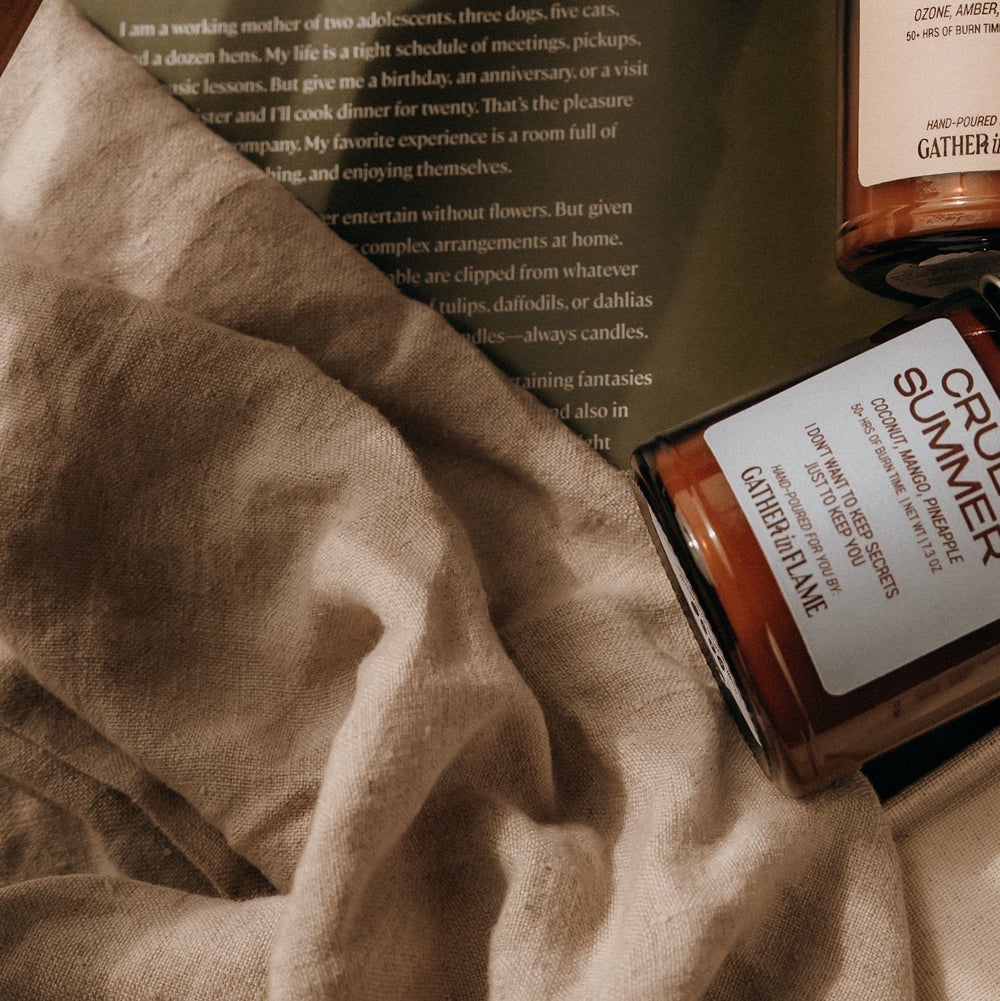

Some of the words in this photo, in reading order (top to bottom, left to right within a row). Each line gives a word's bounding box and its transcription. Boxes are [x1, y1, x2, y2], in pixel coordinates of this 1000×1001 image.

[129, 24, 155, 37] am
[172, 18, 239, 38] working
[241, 16, 301, 33] mother
[303, 14, 322, 30] of
[324, 15, 354, 29] two
[458, 8, 501, 23] three
[550, 3, 579, 19] five
[582, 3, 619, 18] cats,
[914, 5, 952, 22] OZONE,
[956, 2, 1000, 17] AMBER,
[922, 28, 940, 39] HRS
[942, 26, 952, 36] OF
[956, 24, 981, 35] BURN
[165, 49, 215, 65] dozen
[219, 48, 262, 63] hens.
[265, 47, 290, 65] My
[293, 44, 320, 61] life
[323, 44, 336, 60] is
[352, 41, 393, 61] tight
[395, 38, 467, 57] schedule
[471, 35, 487, 53] of
[573, 31, 641, 51] pickups,
[203, 78, 268, 94] lessons.
[270, 76, 299, 92] But
[302, 74, 337, 94] give
[340, 76, 364, 88] me
[456, 72, 476, 84] an
[579, 66, 597, 78] or
[614, 60, 648, 77] visit
[236, 106, 266, 122] and
[294, 104, 333, 121] cook
[336, 102, 389, 120] dinner
[394, 100, 419, 117] for
[422, 100, 479, 117] twenty.
[532, 95, 559, 111] the
[563, 94, 634, 113] pleasure
[926, 116, 997, 131] HAND-POURED
[304, 135, 329, 153] My
[333, 132, 394, 150] favorite
[398, 128, 487, 149] experience
[491, 127, 505, 144] is
[522, 128, 565, 141] room
[569, 123, 596, 140] full
[600, 122, 618, 139] of
[308, 165, 339, 180] and
[343, 161, 414, 182] enjoying
[417, 159, 512, 176] themselves.
[342, 208, 418, 225] entertain
[422, 205, 485, 222] without
[489, 202, 552, 219] flowers.
[555, 201, 586, 216] But
[589, 199, 633, 219] given
[361, 236, 431, 257] complex
[435, 233, 548, 254] arrangements
[552, 233, 567, 248] at
[572, 231, 623, 247] home.
[424, 270, 451, 283] are
[454, 265, 515, 285] clipped
[519, 263, 559, 280] from
[563, 263, 638, 279] whatever
[440, 296, 490, 317] tulips,
[494, 293, 569, 314] daffodils,
[572, 294, 588, 310] or
[592, 291, 653, 309] dahlias
[581, 323, 649, 340] candles.
[578, 369, 653, 387] fantasies
[575, 402, 608, 419] also
[613, 402, 629, 417] in
[871, 397, 907, 449] COCONUT,
[899, 449, 932, 497] MANGO,
[926, 497, 964, 564] PINEAPPLE
[861, 416, 875, 435] HRS
[870, 433, 881, 446] OF
[876, 445, 895, 474] BURN
[887, 469, 905, 494] TIME
[904, 503, 918, 521] NET
[912, 520, 925, 535] WT
[931, 558, 943, 574] OZ
[805, 461, 827, 489] JUST
[817, 488, 837, 506] TO
[827, 504, 852, 538] KEEP
[843, 535, 866, 567] YOU
[823, 454, 849, 489] WANT
[841, 487, 858, 506] TO
[850, 506, 874, 542] KEEP
[865, 541, 900, 599] SECRETS
[771, 464, 813, 533] HAND-POURED
[804, 530, 822, 555] FOR
[815, 553, 832, 576] YOU
[824, 573, 843, 596] BY:
